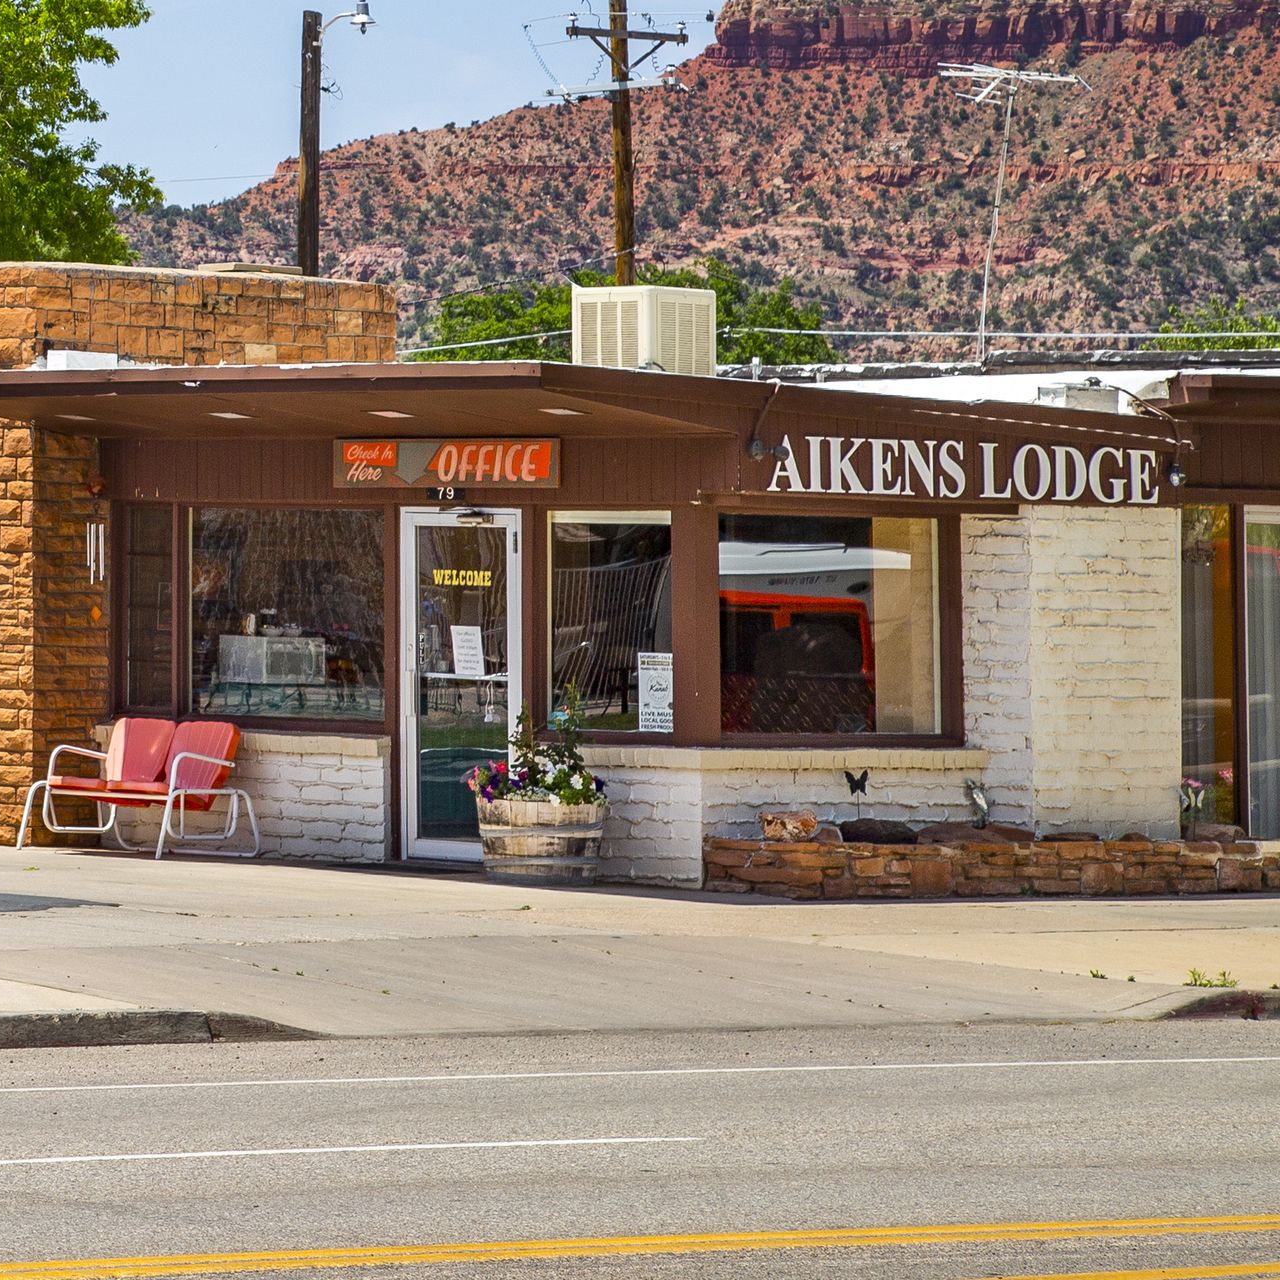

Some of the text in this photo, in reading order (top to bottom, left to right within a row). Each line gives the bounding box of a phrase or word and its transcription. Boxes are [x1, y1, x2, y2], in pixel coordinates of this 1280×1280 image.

[346, 444, 393, 460] Check In
[346, 461, 383, 483] Here
[437, 444, 540, 483] OFFICE
[766, 433, 1160, 505] AIKENS LODGE
[437, 487, 455, 500] 79
[432, 569, 492, 587] WELCOME
